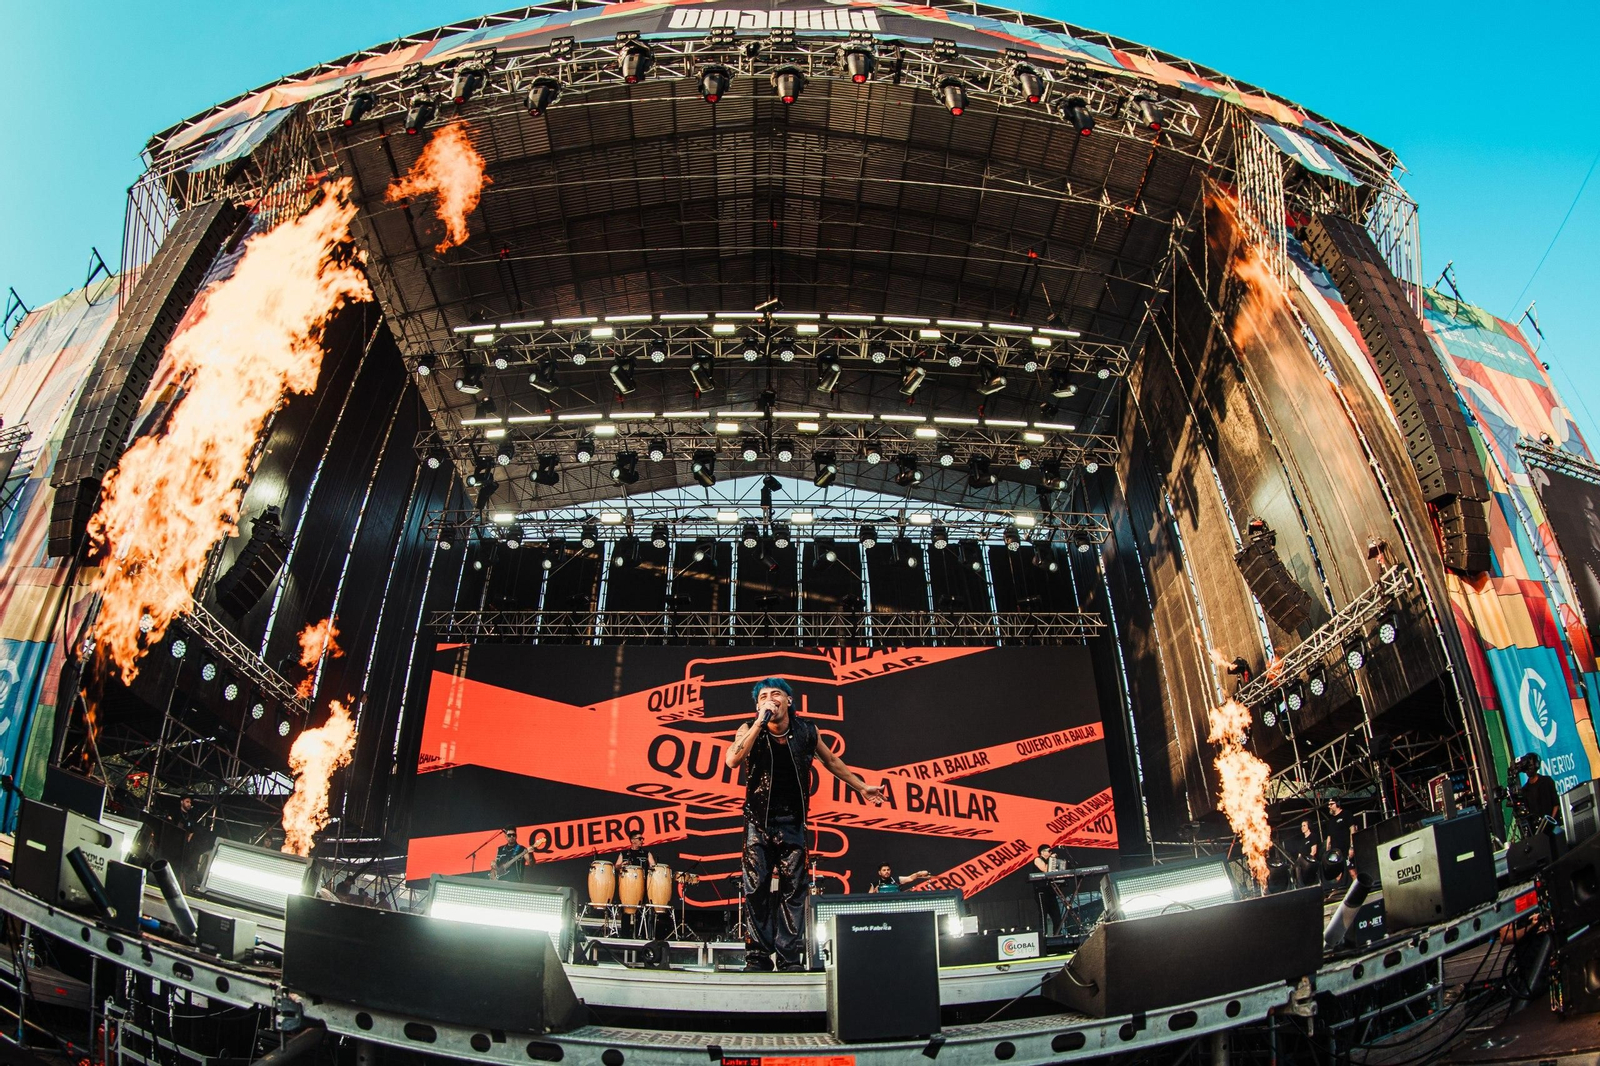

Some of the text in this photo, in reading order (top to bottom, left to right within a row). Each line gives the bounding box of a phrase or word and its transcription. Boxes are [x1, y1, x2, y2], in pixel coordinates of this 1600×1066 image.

[1016, 725, 1097, 756] QUIERO IR A BAILAR
[914, 763, 932, 780] IR
[933, 761, 945, 777] A
[944, 751, 991, 774] BAILAR
[906, 782, 1000, 823] BAILAR
[529, 810, 681, 853] QUIERO IR
[1046, 811, 1081, 834] QUIERO
[1073, 807, 1090, 818] IR
[1082, 804, 1095, 814] A
[978, 858, 995, 873] A
[986, 839, 1032, 867] BAILAR
[961, 863, 984, 881] IR
[1397, 864, 1421, 879] EXPLO
[1008, 942, 1036, 950] GLOBAL
